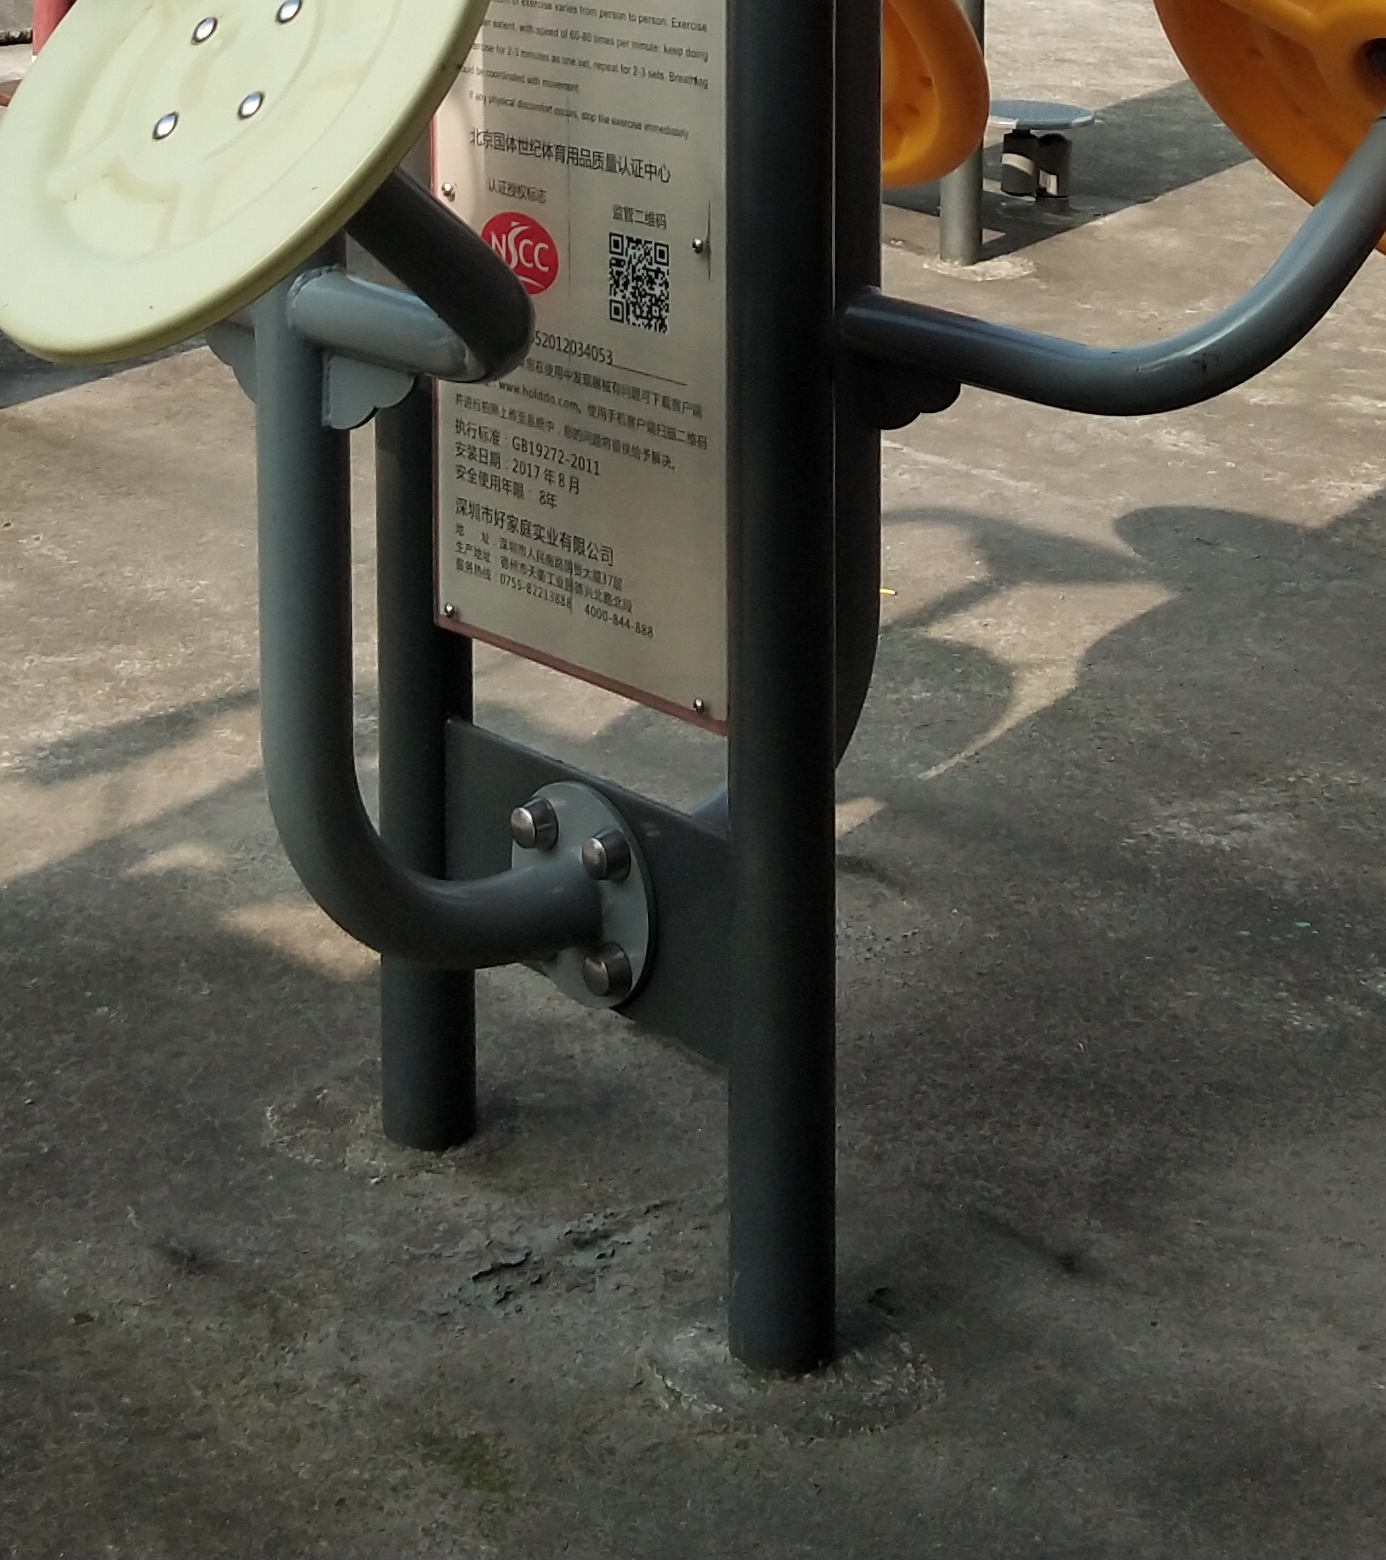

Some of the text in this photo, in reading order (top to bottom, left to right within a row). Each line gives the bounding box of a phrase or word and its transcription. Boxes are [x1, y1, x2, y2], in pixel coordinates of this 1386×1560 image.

[580, 5, 597, 16] from
[599, 9, 627, 20] person
[628, 12, 636, 22] to
[671, 17, 708, 33] Exercise
[616, 38, 629, 49] per
[685, 47, 708, 63] doing
[621, 64, 631, 75] for
[598, 113, 610, 125] the
[611, 117, 642, 131] exercise
[470, 127, 671, 184] 北京国体世纪体育用品质量认证中心
[491, 222, 550, 272] NSCC
[532, 330, 613, 366] 52012034053
[455, 496, 614, 567] 深圳市好家庭实业有限公司
